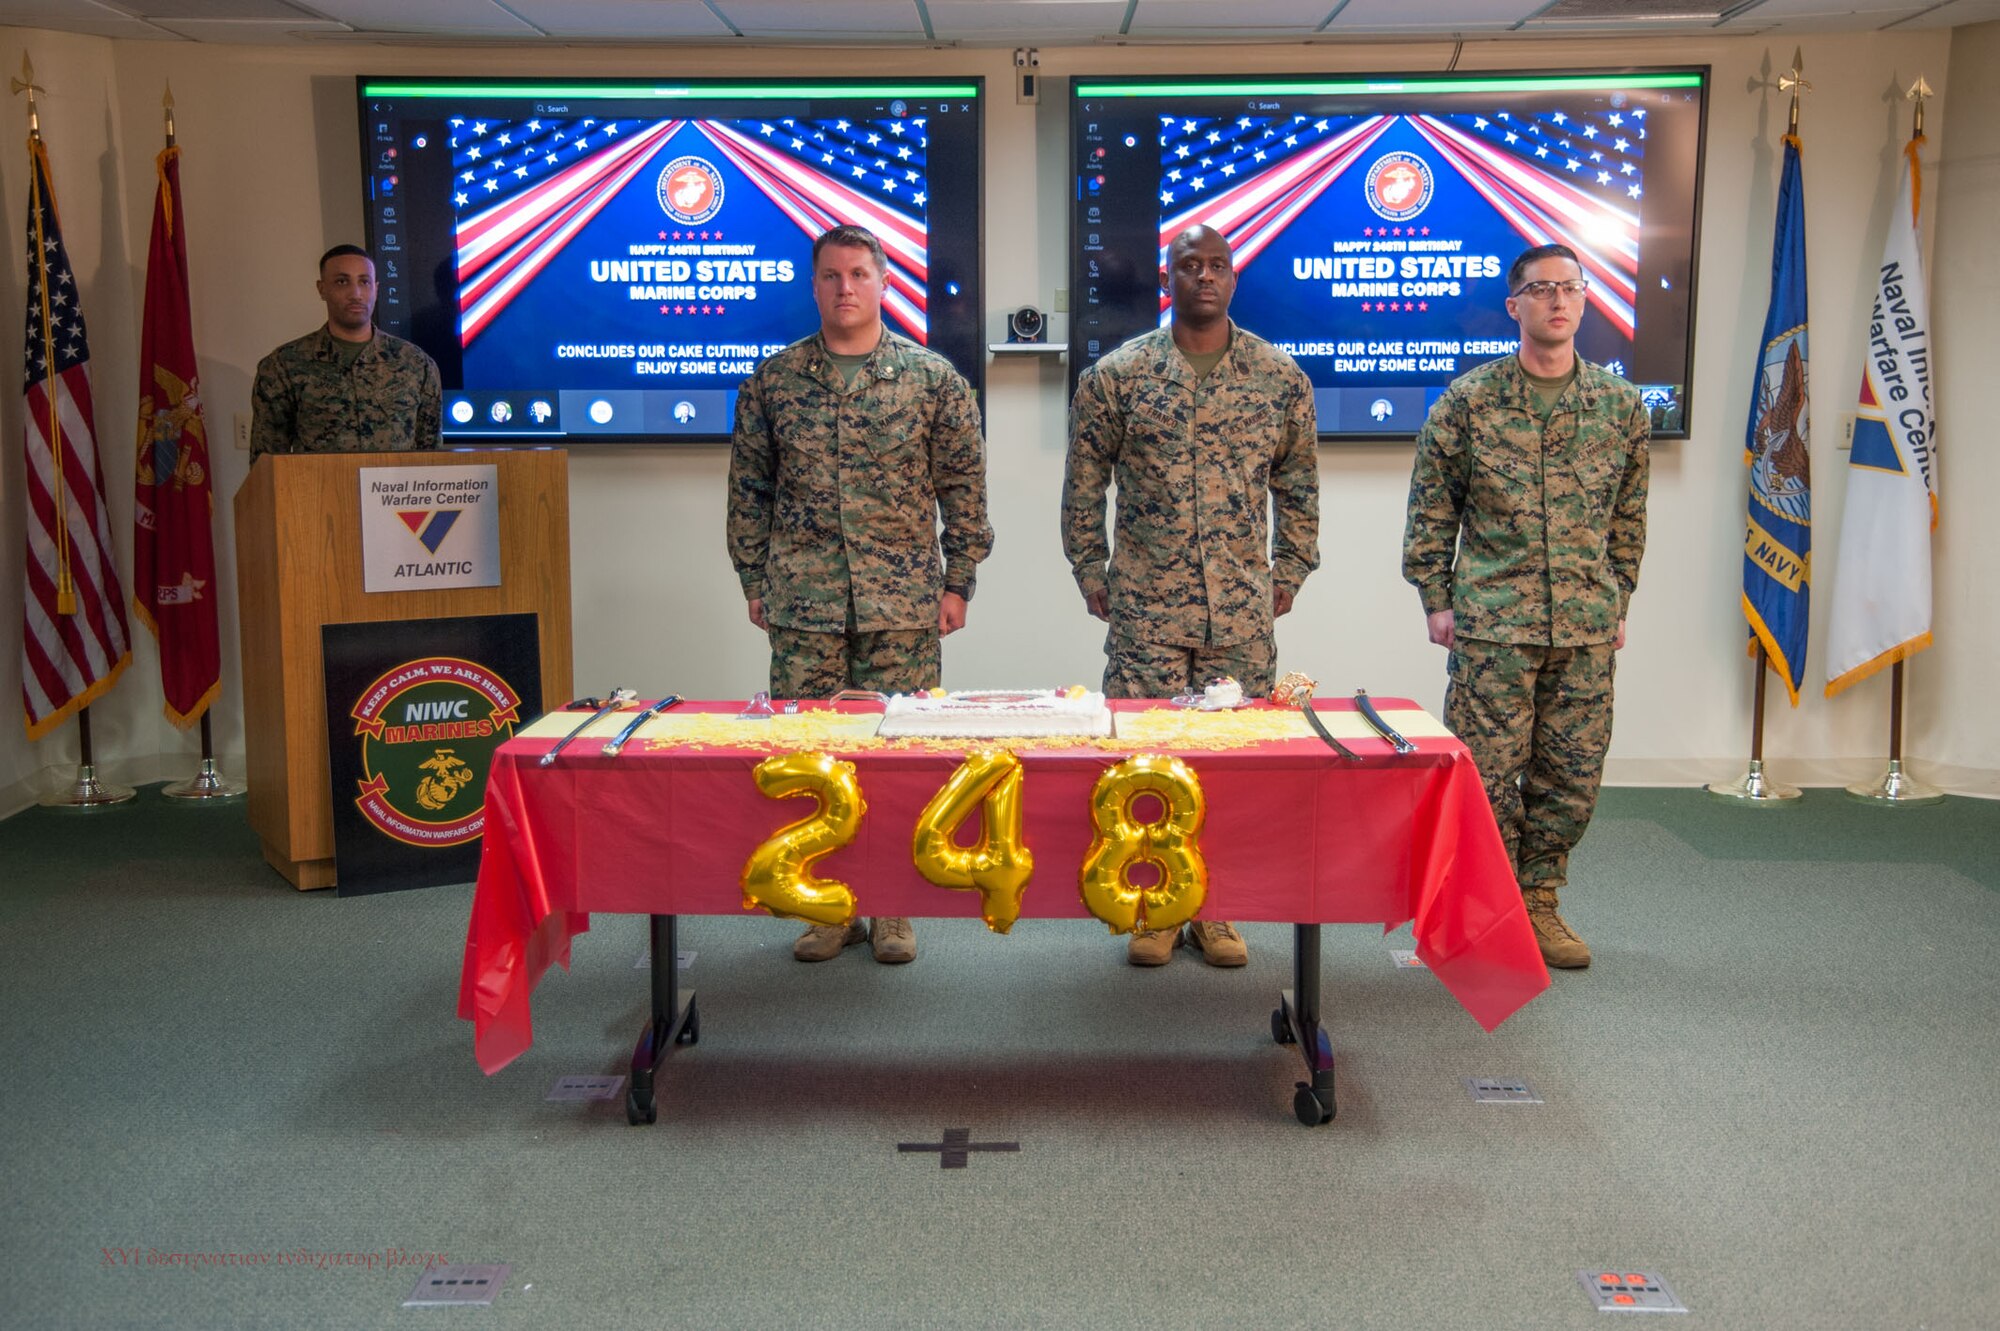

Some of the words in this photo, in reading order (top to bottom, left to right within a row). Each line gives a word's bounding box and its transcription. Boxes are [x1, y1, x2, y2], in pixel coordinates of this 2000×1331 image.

[548, 105, 569, 113] Search
[1259, 102, 1280, 110] Search
[630, 245, 667, 255] HAPPY
[703, 245, 756, 255] BIRTHDAY
[1334, 242, 1371, 252] HAPPY
[1408, 240, 1463, 252] BIRTHDAY
[591, 261, 691, 282] UNITED
[696, 260, 795, 282] STATES
[1294, 257, 1395, 279] UNITED
[1400, 256, 1501, 278] STATES
[630, 286, 696, 300] MARINE
[698, 286, 757, 300] CORPS
[1332, 283, 1399, 297] MARINE
[1402, 282, 1461, 297] CORPS
[1881, 261, 1925, 341] Naval
[558, 345, 635, 358] CONCLUDES
[639, 345, 666, 358] OUR
[669, 345, 704, 358] CAKE
[706, 345, 759, 358] CUTTING
[1338, 343, 1365, 356] OUR
[1368, 342, 1404, 356] CAKE
[1406, 342, 1461, 355] CUTTING
[1464, 341, 1521, 354] CEREMO
[637, 362, 678, 375] ENJOY
[680, 362, 716, 375] SOME
[720, 362, 754, 375] CAKE
[1335, 359, 1376, 372] ENJOY
[1379, 359, 1416, 372] SOME
[1419, 358, 1455, 371] CAKE
[371, 481, 408, 493] Naval
[412, 479, 489, 492] Information
[381, 494, 432, 506] Warfare
[436, 493, 481, 504] Center
[1755, 541, 1800, 580] NAVY
[394, 561, 472, 577] ATLANTIC
[362, 686, 388, 717] KEEP
[389, 667, 429, 688] CALM,
[430, 666, 452, 674] WE
[454, 668, 482, 683] ARE
[481, 679, 510, 708] HERE
[405, 700, 469, 722] NIWC
[385, 719, 493, 744] MARINES
[368, 799, 387, 820] NAVAL
[385, 816, 433, 838] INFORMATION
[433, 826, 469, 839] WARFARE
[468, 817, 486, 831] CEN
